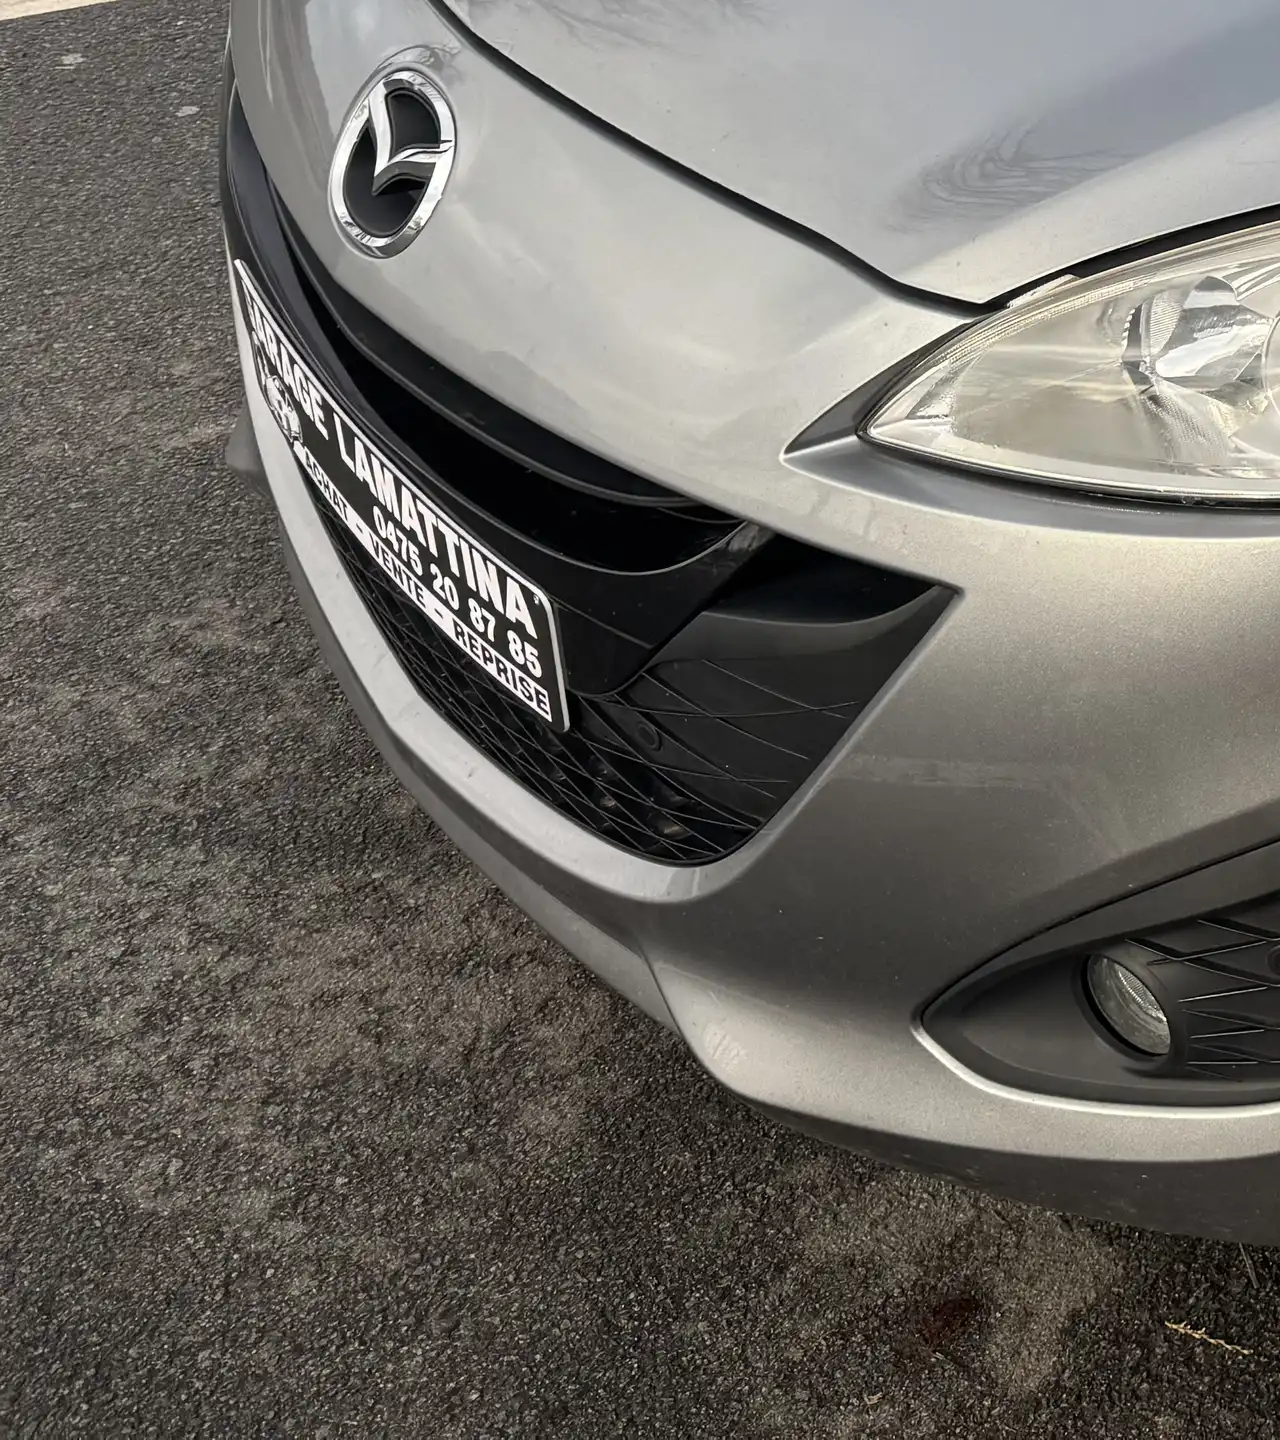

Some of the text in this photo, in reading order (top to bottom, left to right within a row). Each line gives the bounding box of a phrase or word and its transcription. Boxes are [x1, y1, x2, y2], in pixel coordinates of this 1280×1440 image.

[303, 451, 350, 522] ACHAT
[373, 538, 427, 608] VENTE
[452, 621, 549, 717] REPRISE
[333, 412, 538, 639] LAMATTINA
[373, 505, 542, 678] 0475 20 87 85
